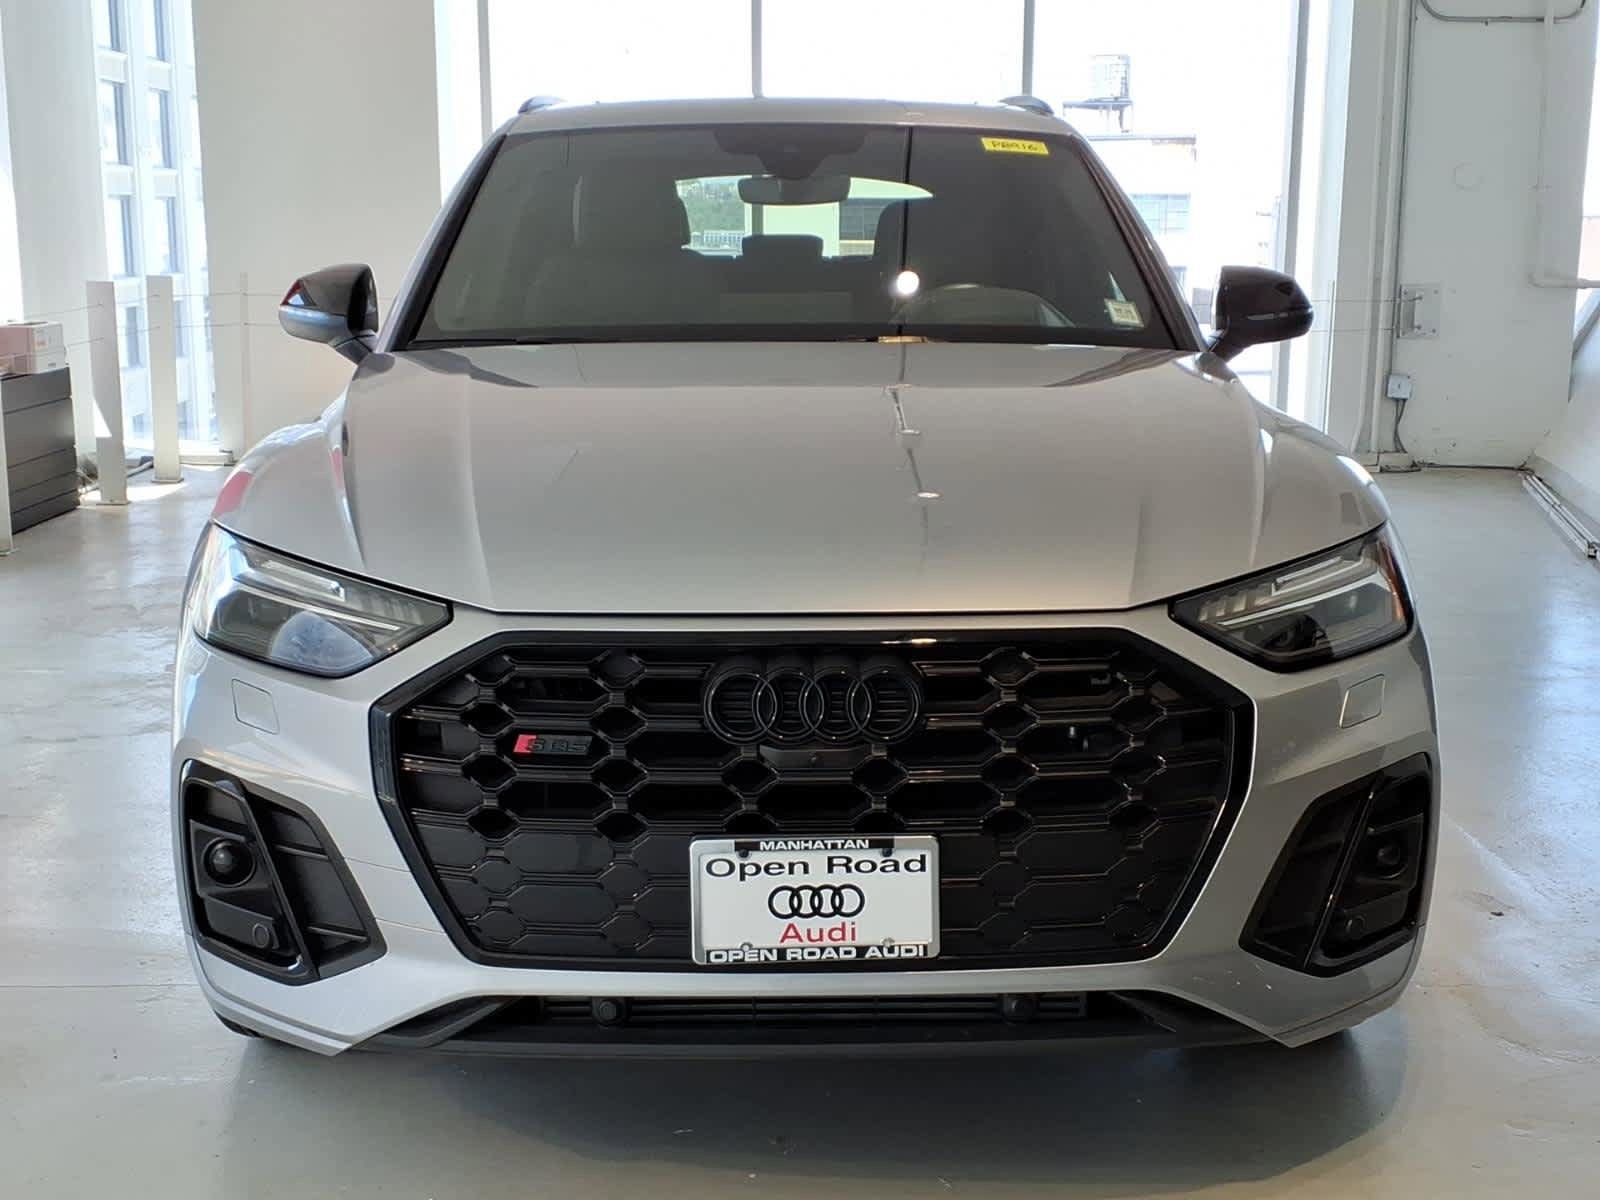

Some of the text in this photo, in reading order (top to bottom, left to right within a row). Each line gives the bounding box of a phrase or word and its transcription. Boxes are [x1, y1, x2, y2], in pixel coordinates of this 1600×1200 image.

[760, 839, 869, 850] MANHATTAN
[705, 854, 927, 881] Open Road
[779, 922, 857, 944] Audi
[709, 944, 924, 963] OPEN ROAD AUDI
